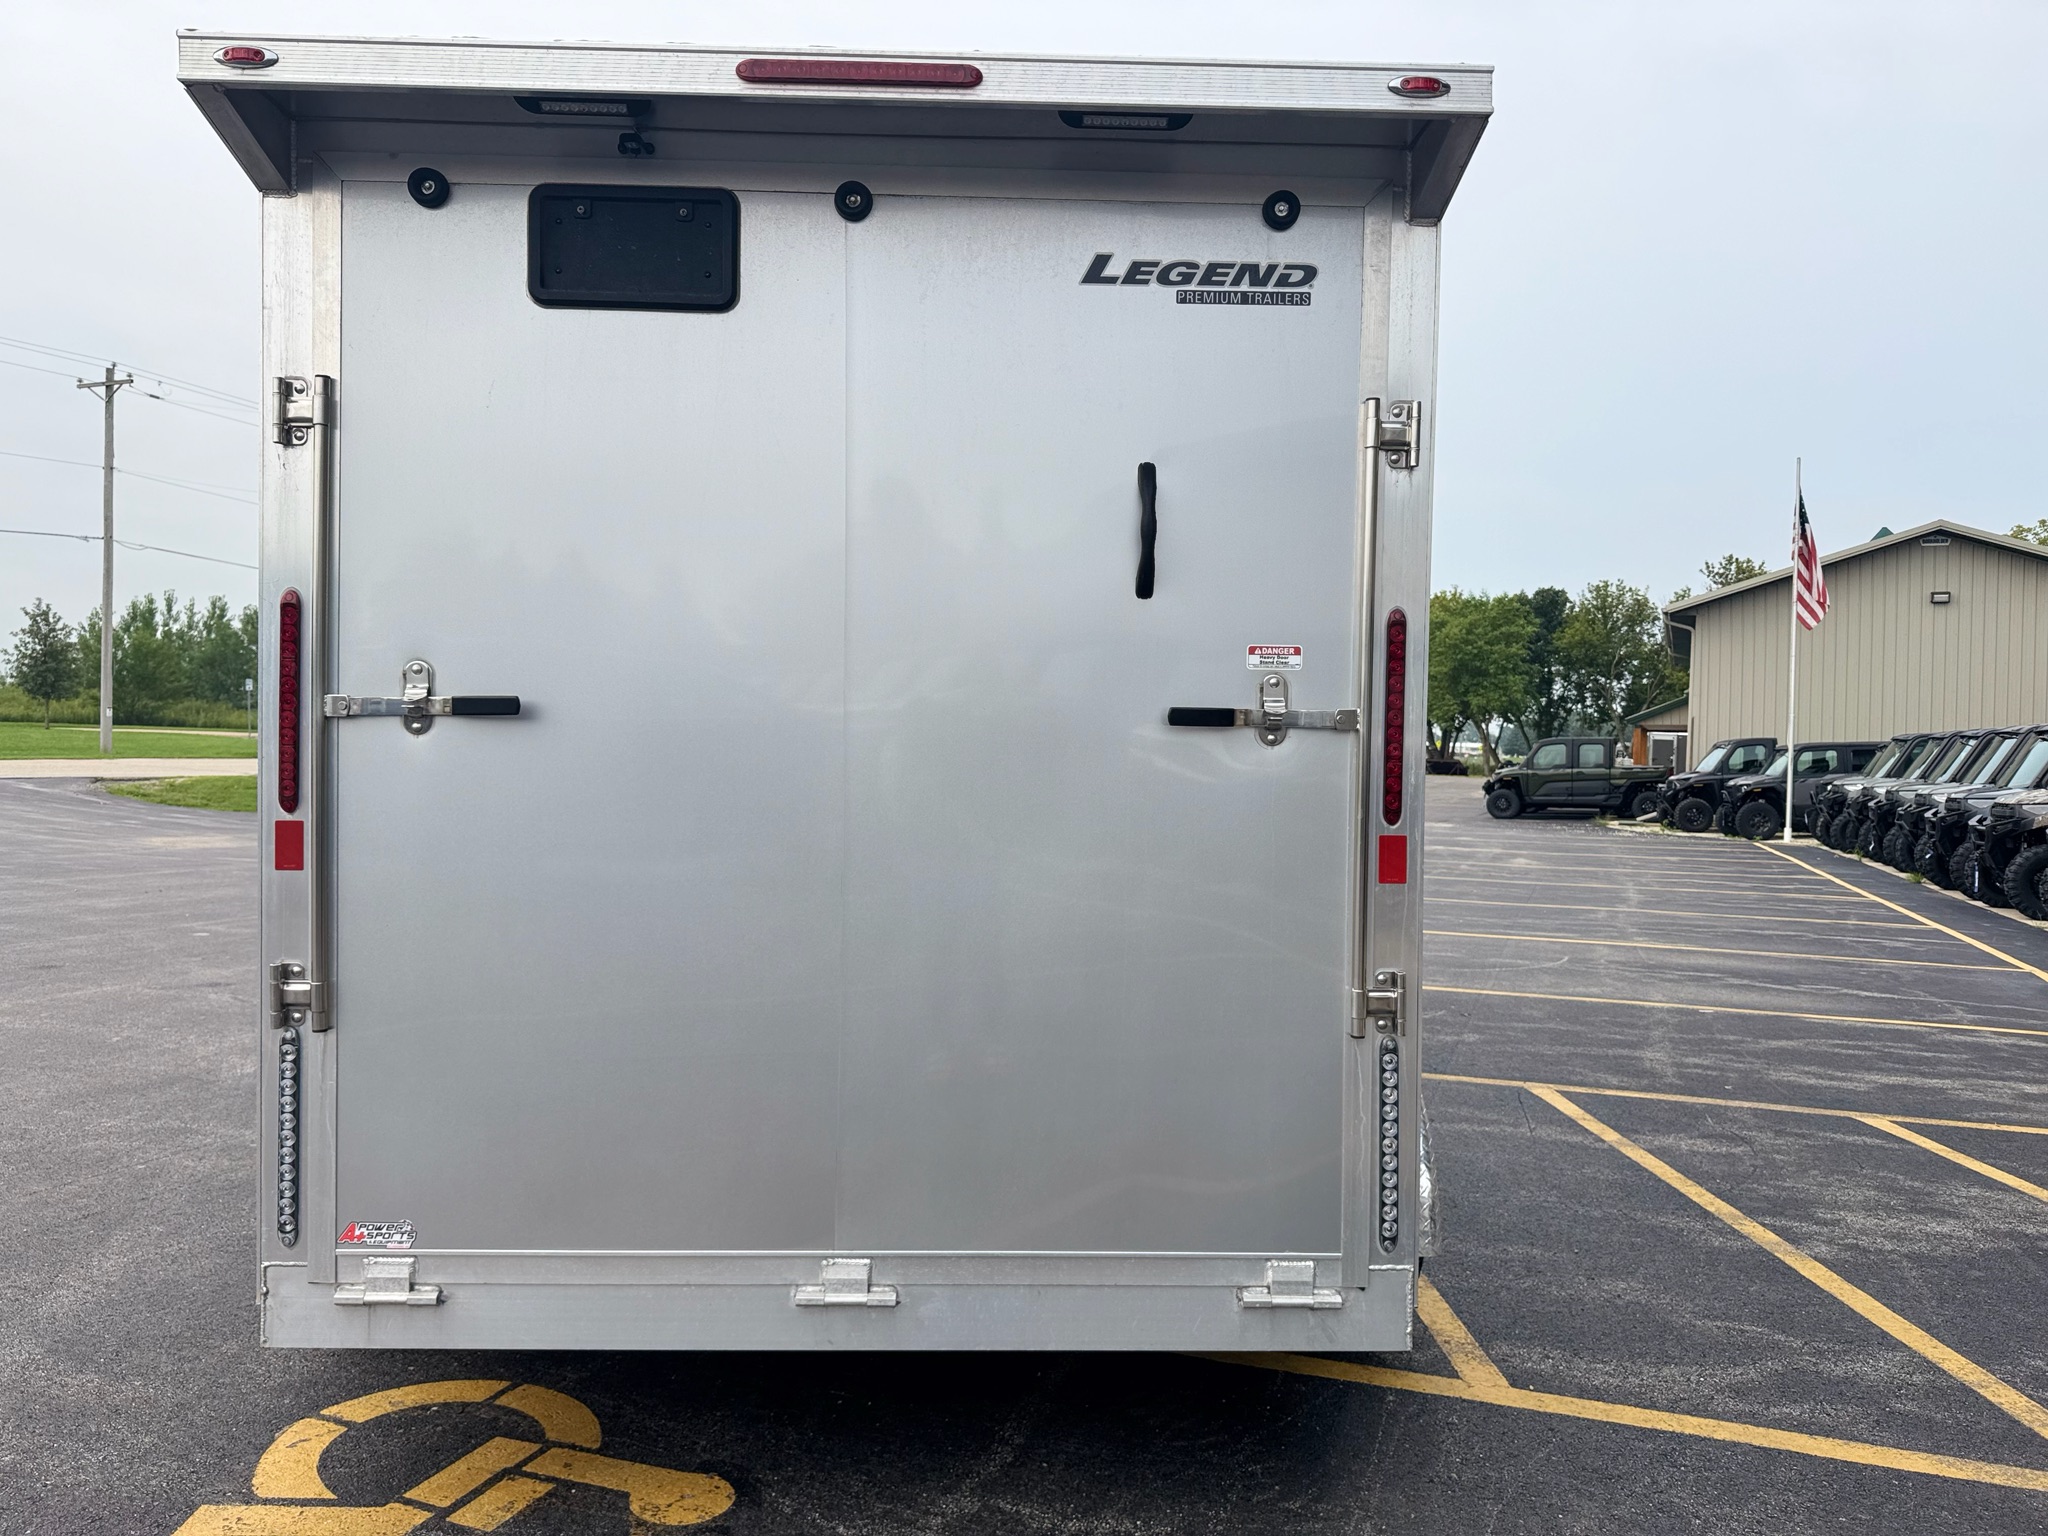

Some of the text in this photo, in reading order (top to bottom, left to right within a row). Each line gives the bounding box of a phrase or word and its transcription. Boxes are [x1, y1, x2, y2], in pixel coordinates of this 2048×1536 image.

[1079, 252, 1319, 289] LEGEND
[1177, 291, 1310, 306] PREMIUM TRAILERS
